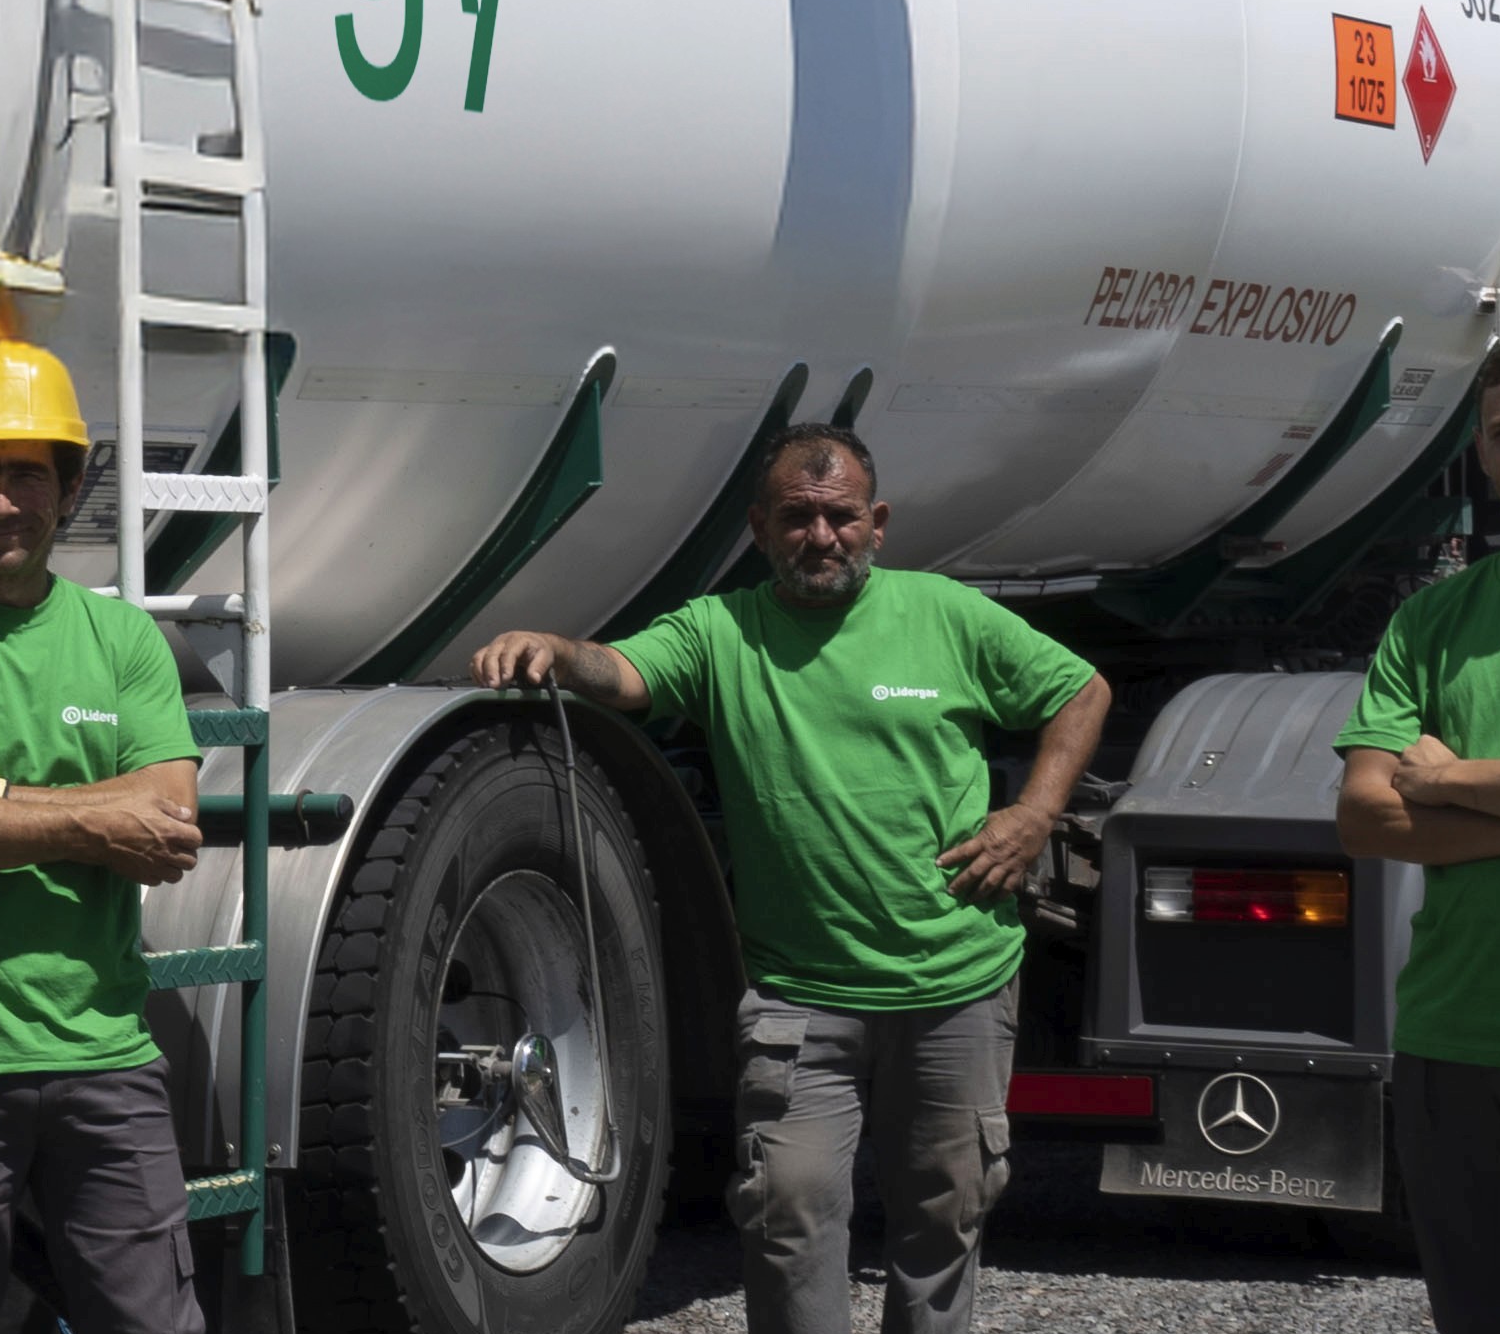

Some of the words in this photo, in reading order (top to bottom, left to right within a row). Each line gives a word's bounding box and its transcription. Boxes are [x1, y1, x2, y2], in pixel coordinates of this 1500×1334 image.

[1354, 29, 1377, 67] 23
[1349, 74, 1386, 116] 1075
[1083, 266, 1196, 330] PELIGRO
[1189, 278, 1357, 347] EXPLOSIVO
[889, 687, 938, 700] Lidergas
[1140, 1161, 1336, 1199] Mercedes-Benz
